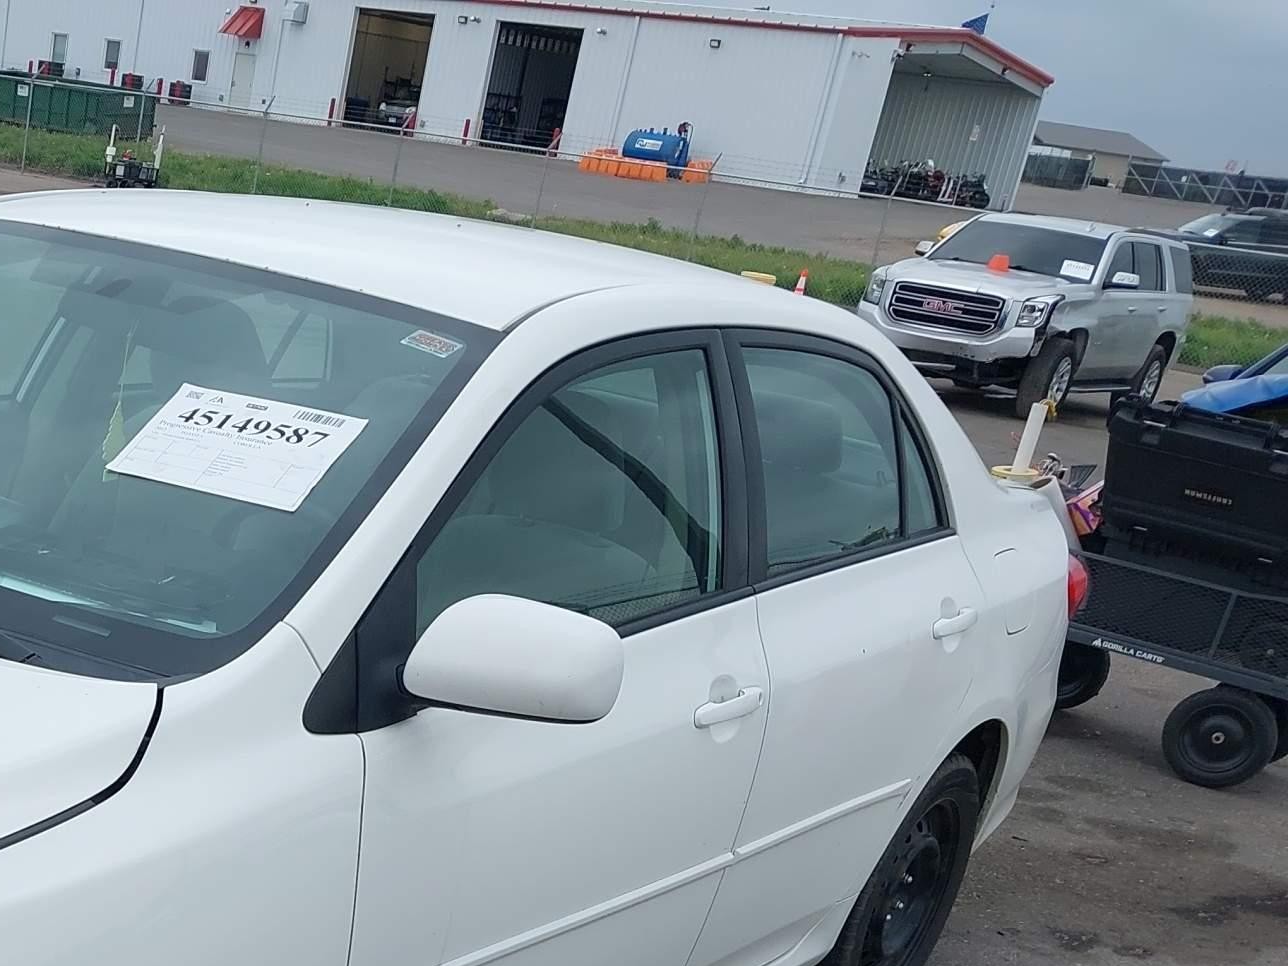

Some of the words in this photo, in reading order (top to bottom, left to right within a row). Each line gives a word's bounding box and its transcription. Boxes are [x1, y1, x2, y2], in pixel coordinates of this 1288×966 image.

[923, 299, 964, 315] GMC
[177, 407, 331, 448] 45149587
[1102, 640, 1134, 655] GORILLA
[1135, 650, 1165, 663] CARTS
